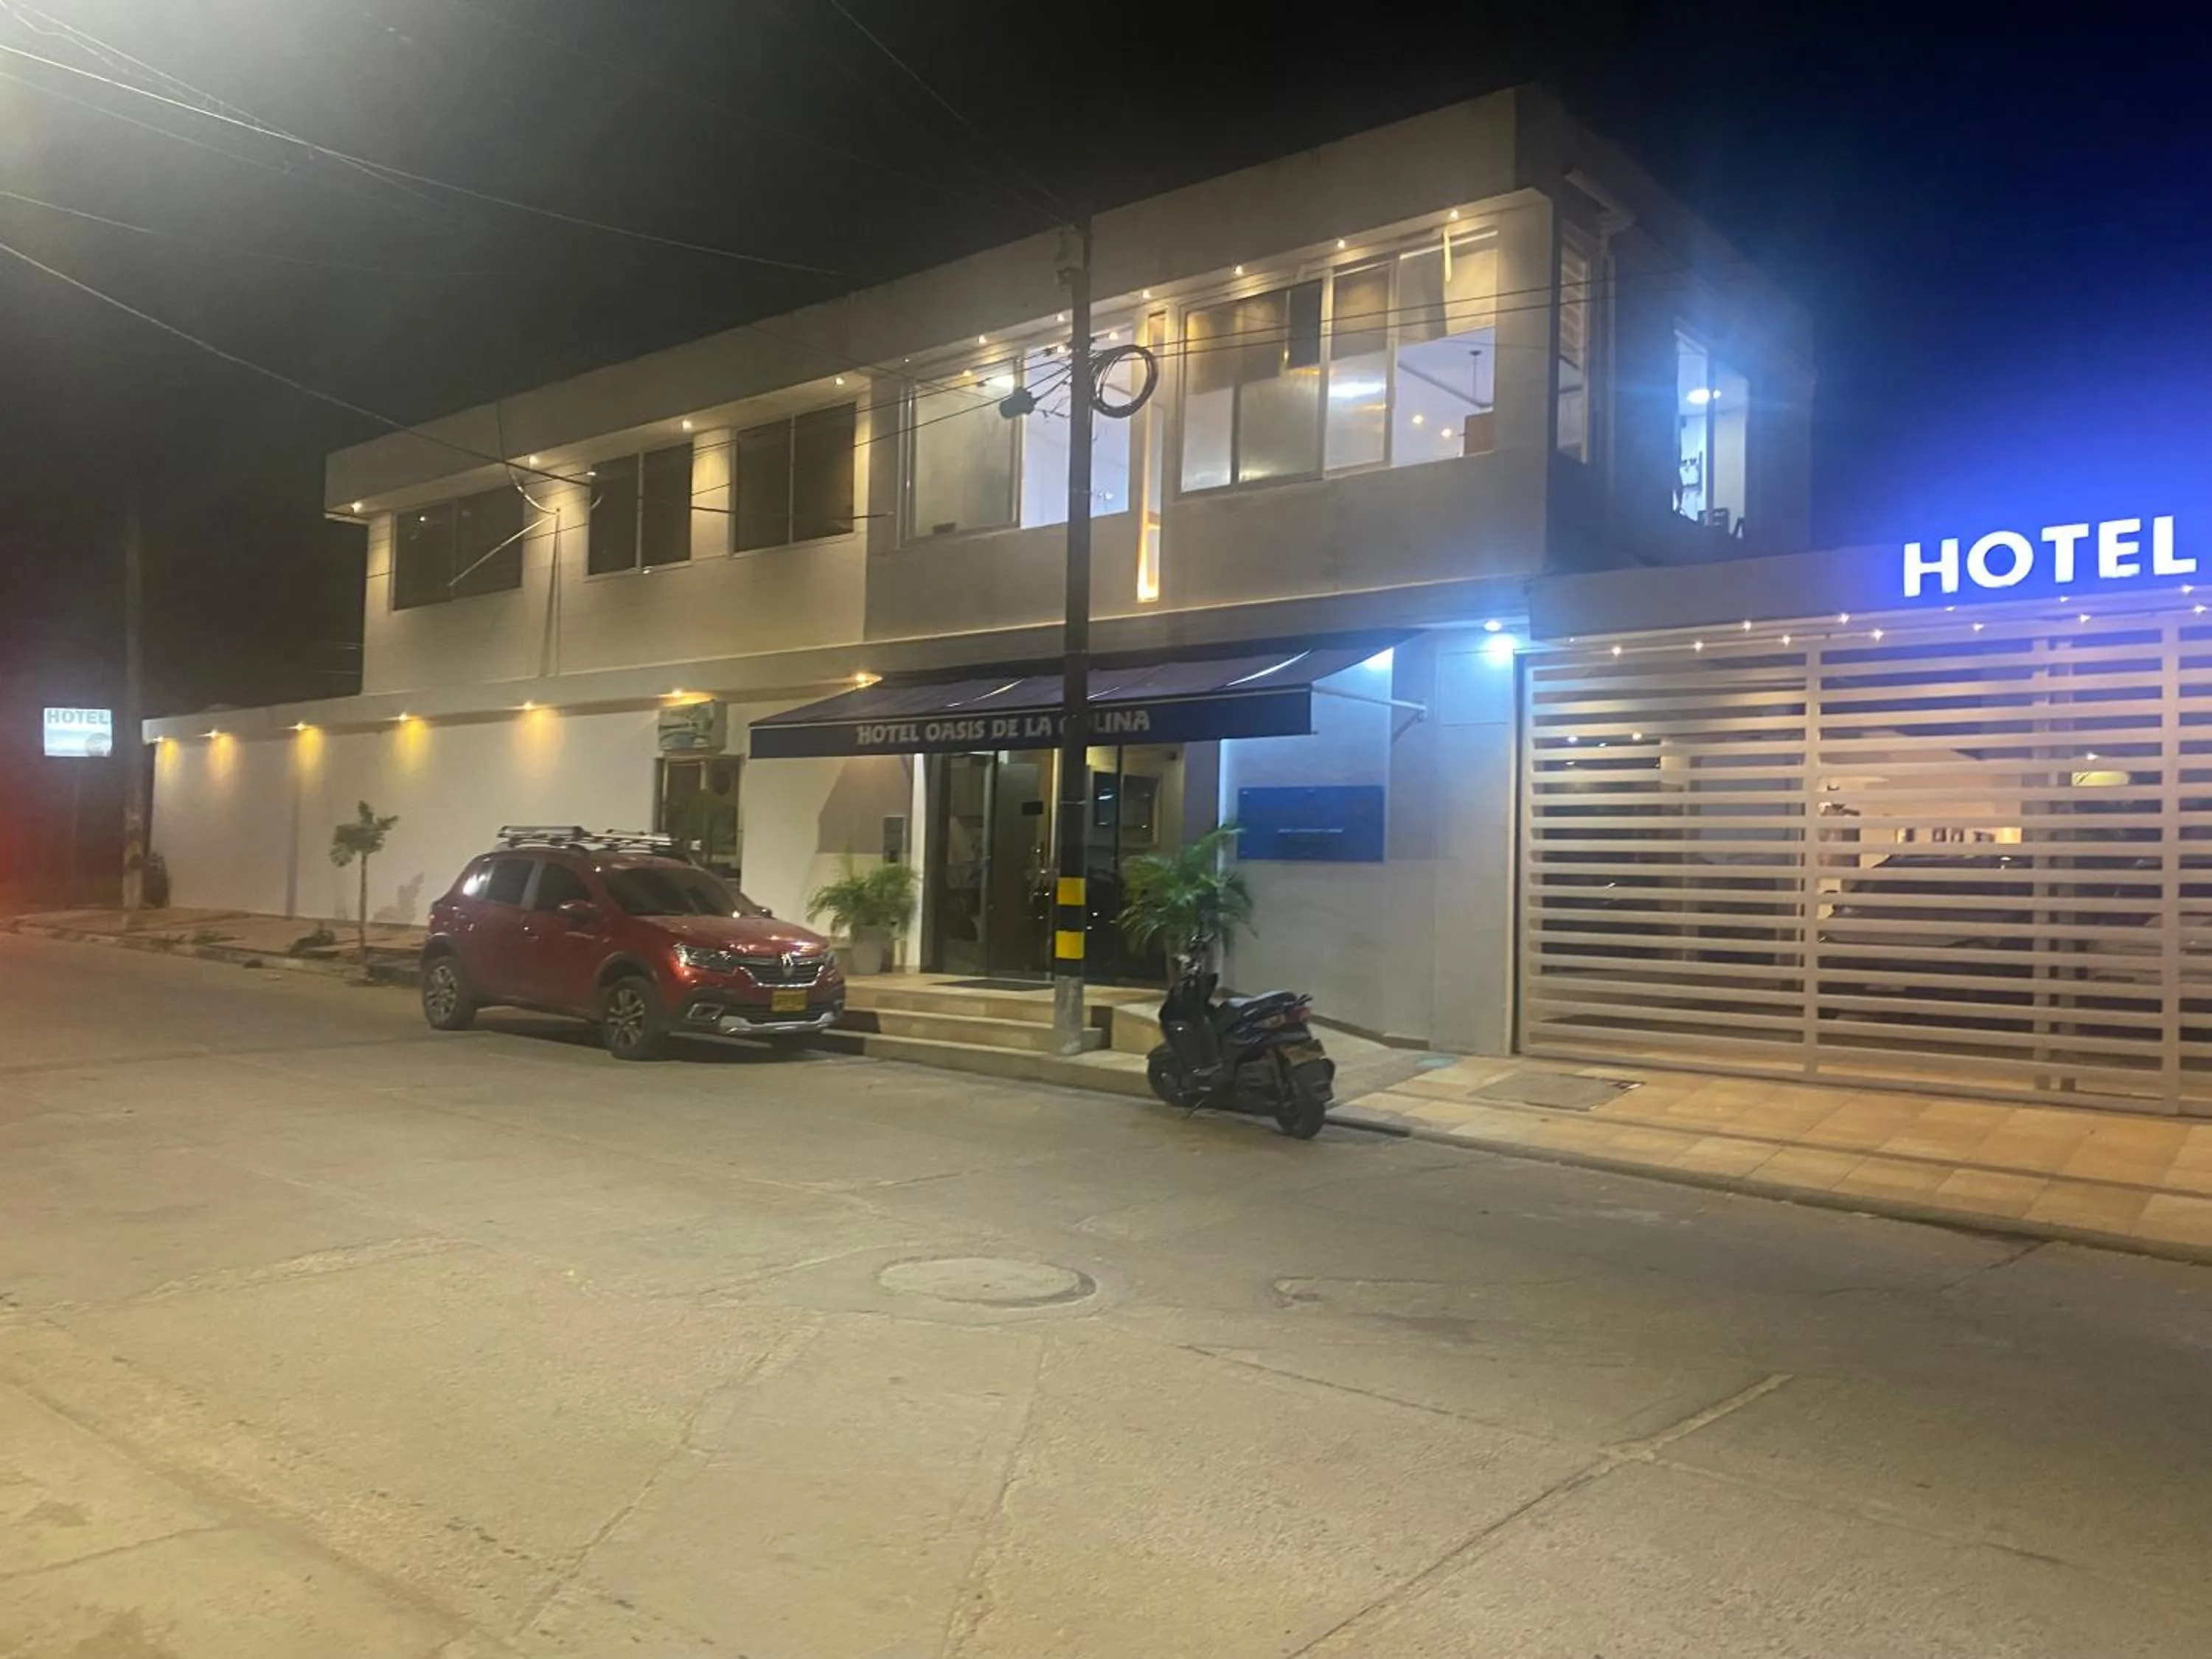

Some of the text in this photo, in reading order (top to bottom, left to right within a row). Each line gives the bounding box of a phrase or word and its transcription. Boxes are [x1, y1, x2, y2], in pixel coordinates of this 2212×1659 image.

[1903, 515, 2197, 597] HOTEL
[47, 710, 109, 724] HOTEL
[856, 709, 1150, 745] HOTEL OASIS DE LA LINA
